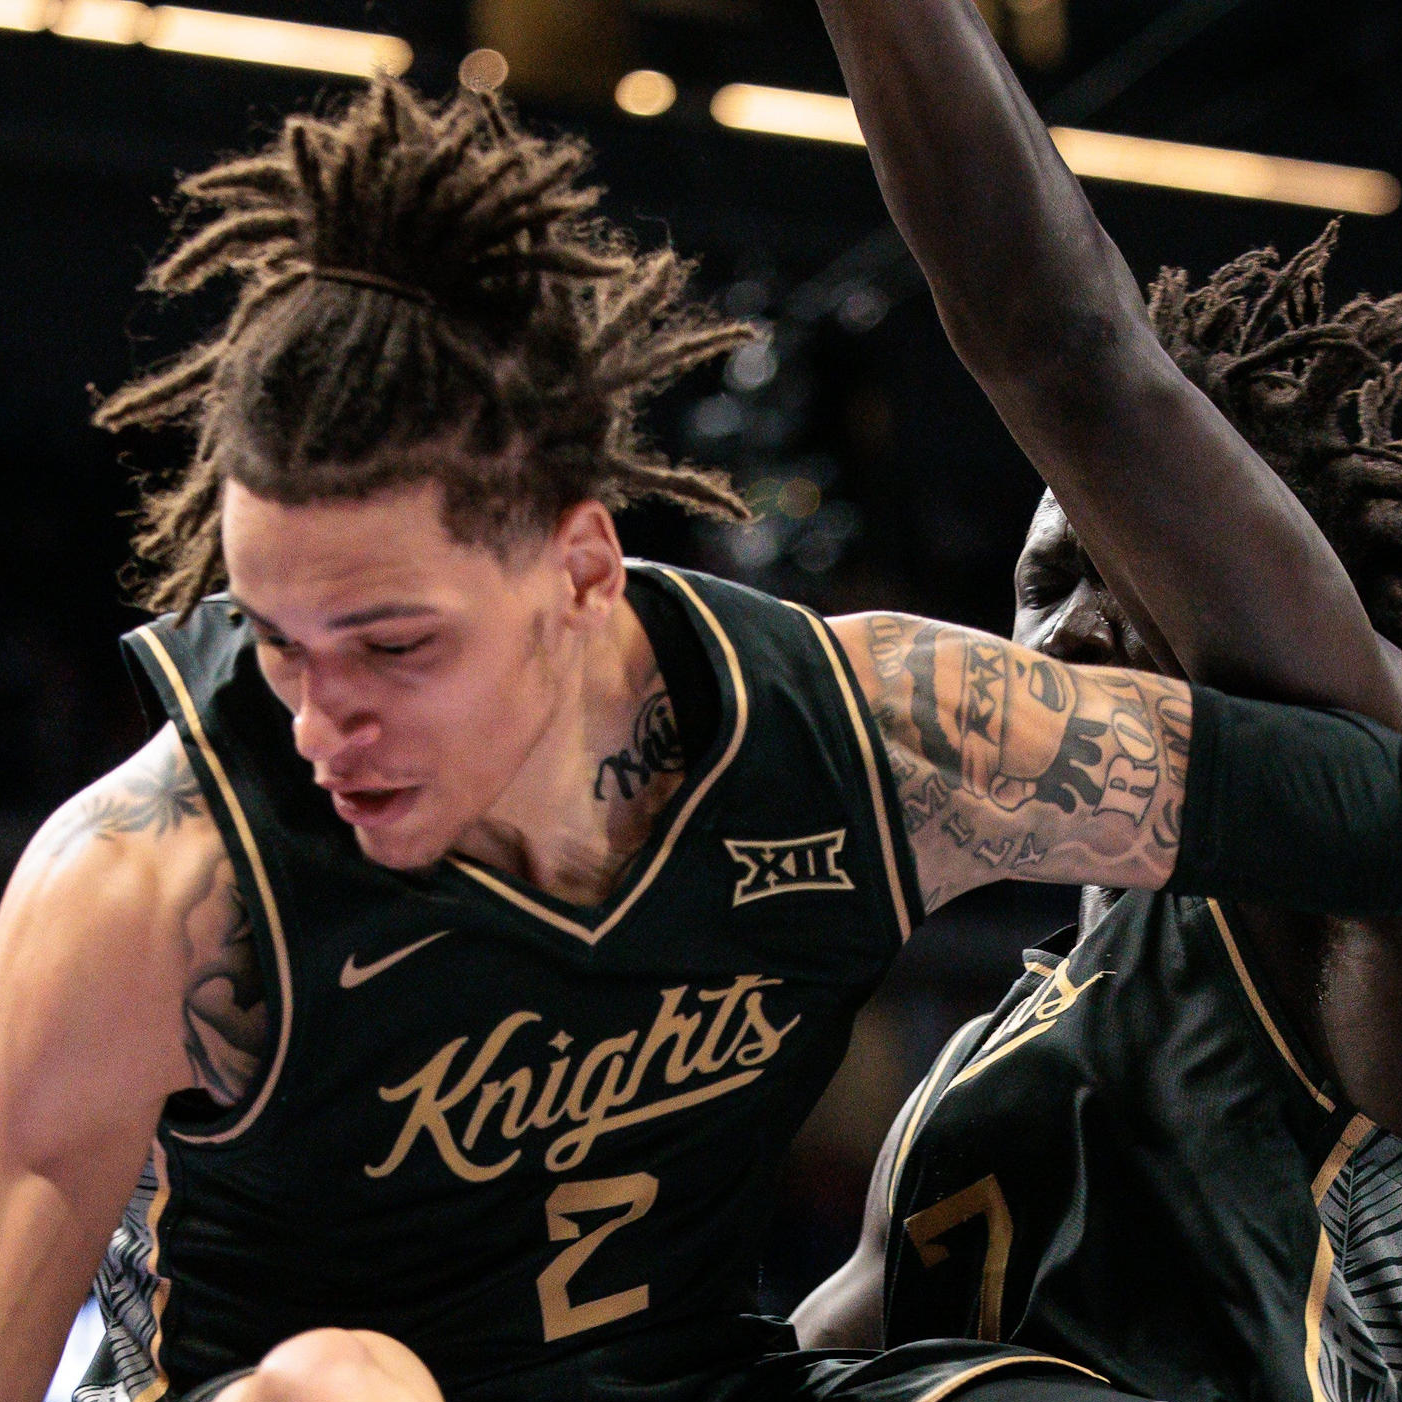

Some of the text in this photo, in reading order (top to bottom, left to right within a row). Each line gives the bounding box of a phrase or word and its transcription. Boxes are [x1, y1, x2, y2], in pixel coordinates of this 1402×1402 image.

[721, 828, 855, 908] XII
[364, 973, 801, 1183] Knights
[536, 1171, 659, 1343] 2
[903, 1172, 1014, 1343] 7
